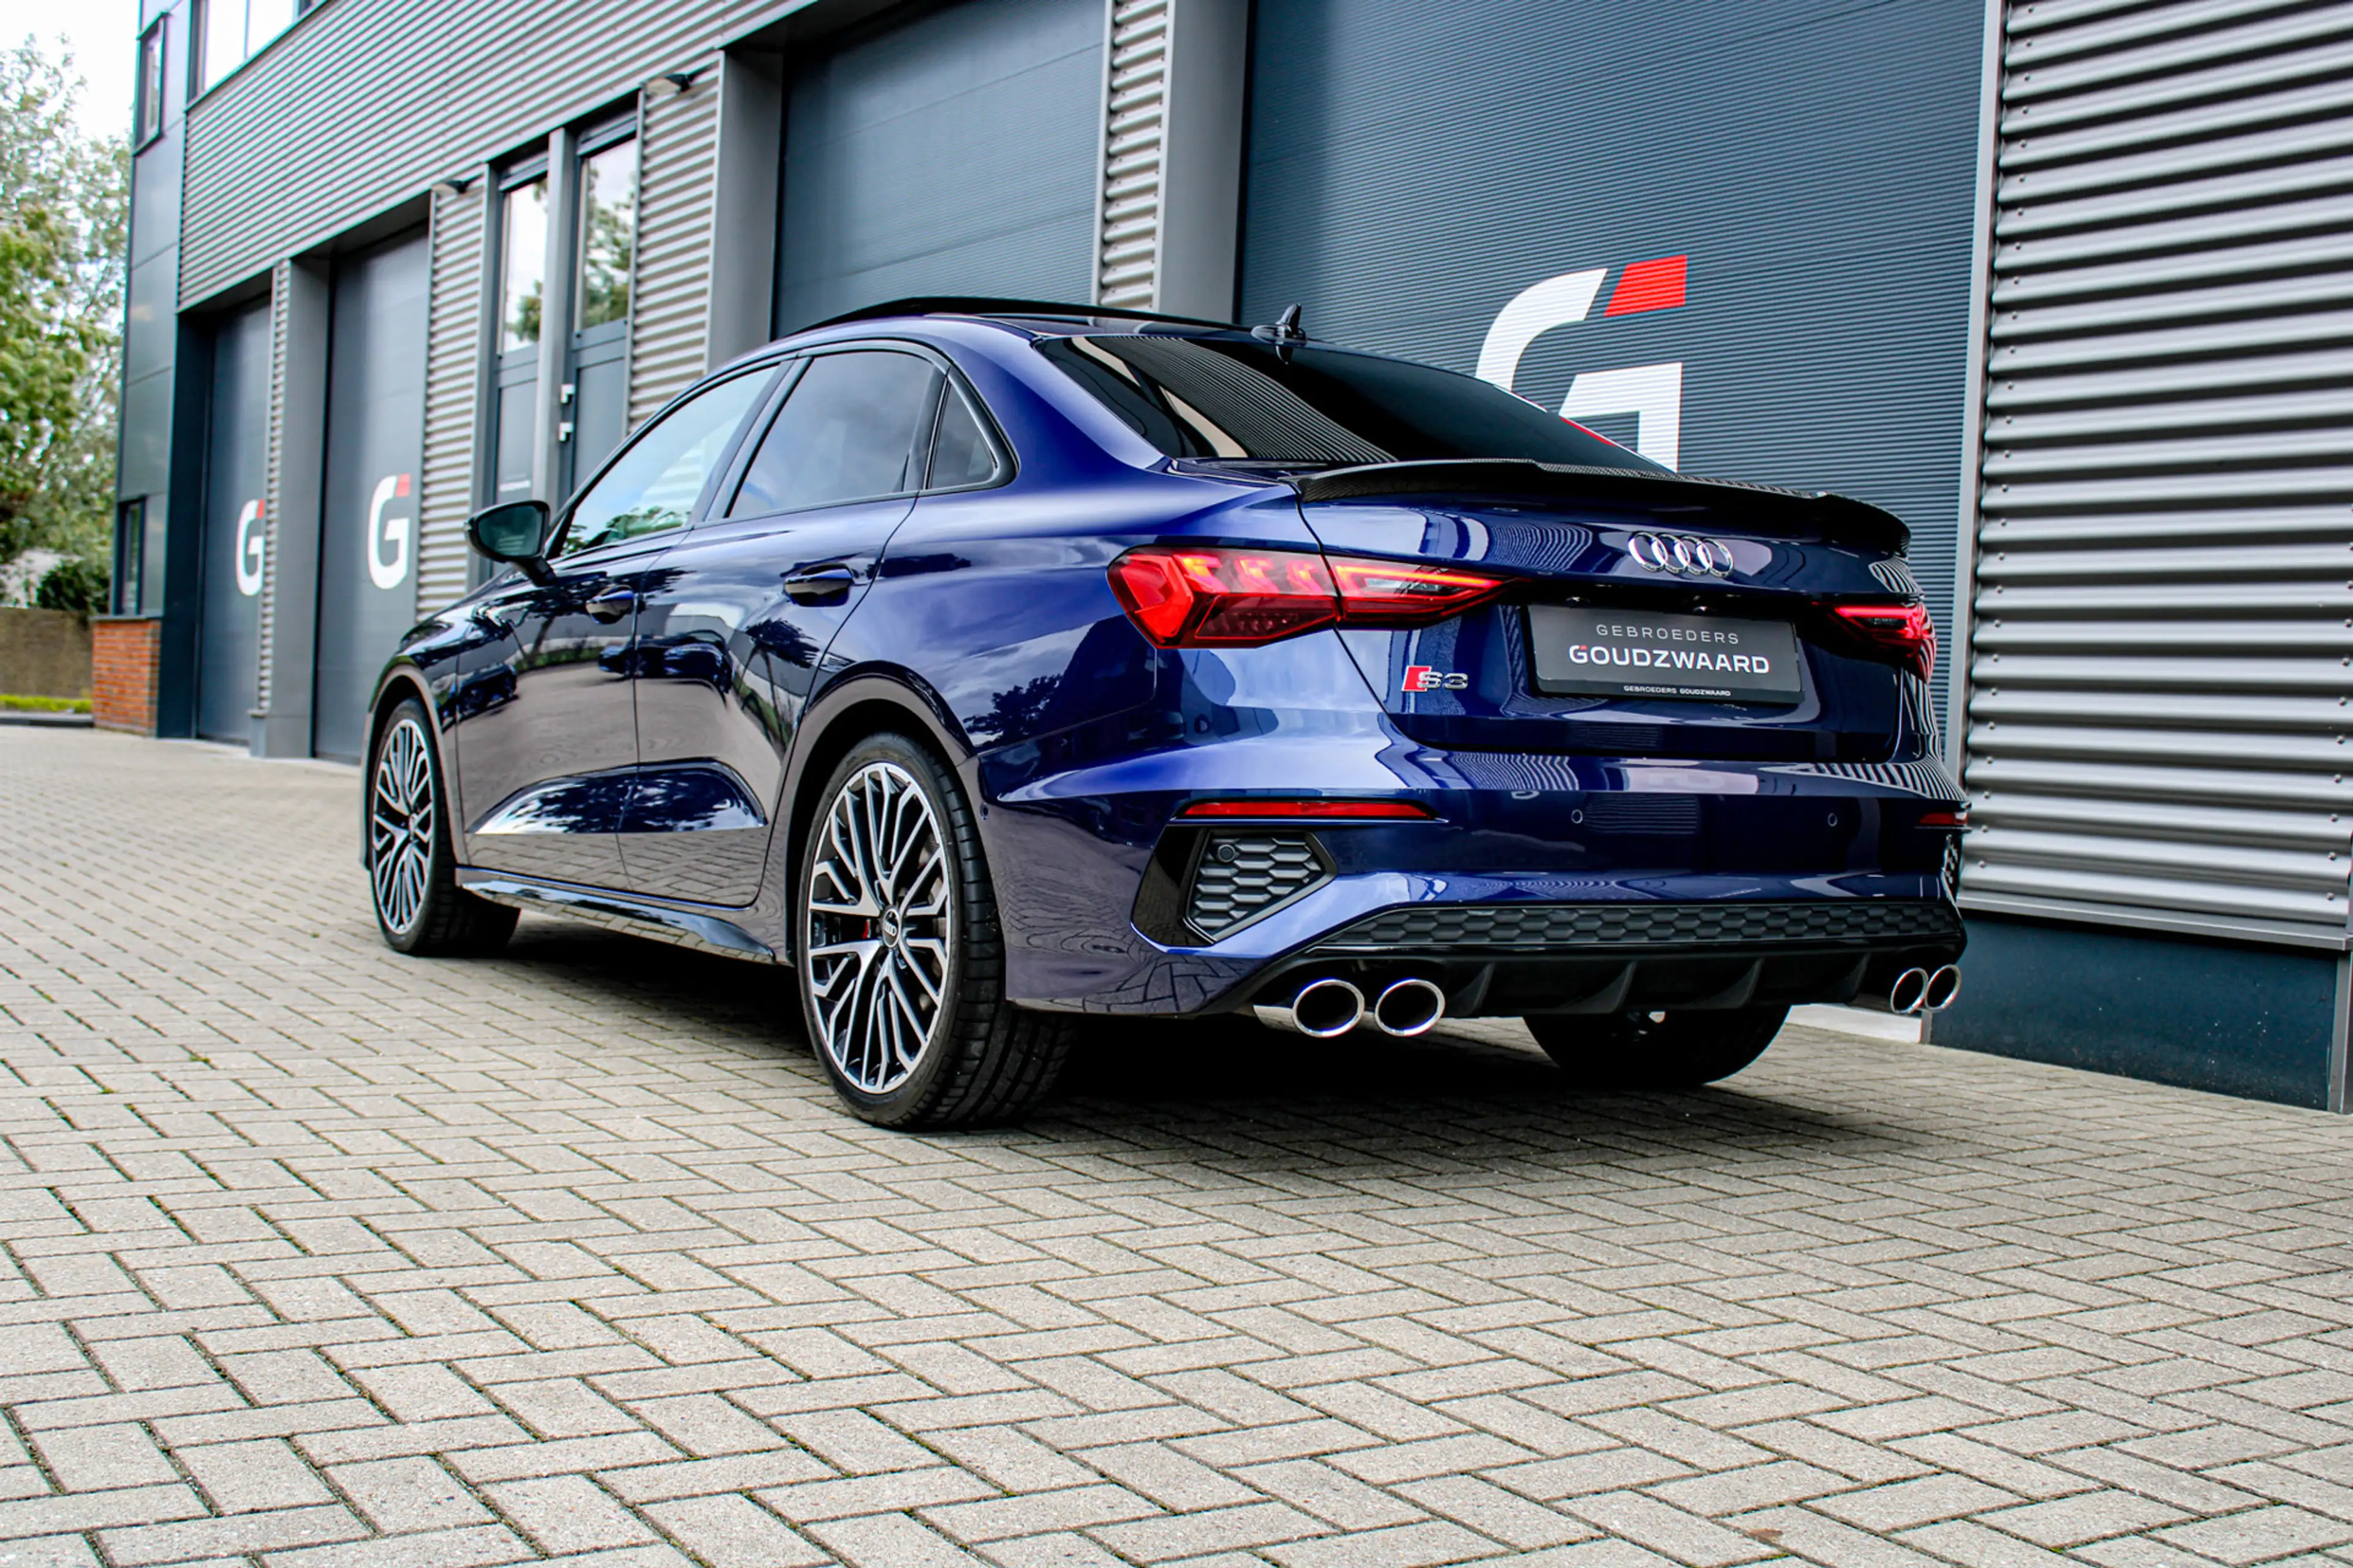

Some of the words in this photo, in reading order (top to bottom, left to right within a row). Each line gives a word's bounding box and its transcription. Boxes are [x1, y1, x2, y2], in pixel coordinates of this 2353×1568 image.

[368, 473, 411, 589] G
[236, 499, 265, 596] G
[1596, 623, 1739, 645] GEBROEDERS
[1568, 644, 1771, 675] GOUDZWAARD
[1416, 672, 1468, 689] S3
[1623, 684, 1677, 694] GEBROEDERS
[1680, 687, 1732, 697] GOUDZWAARD
